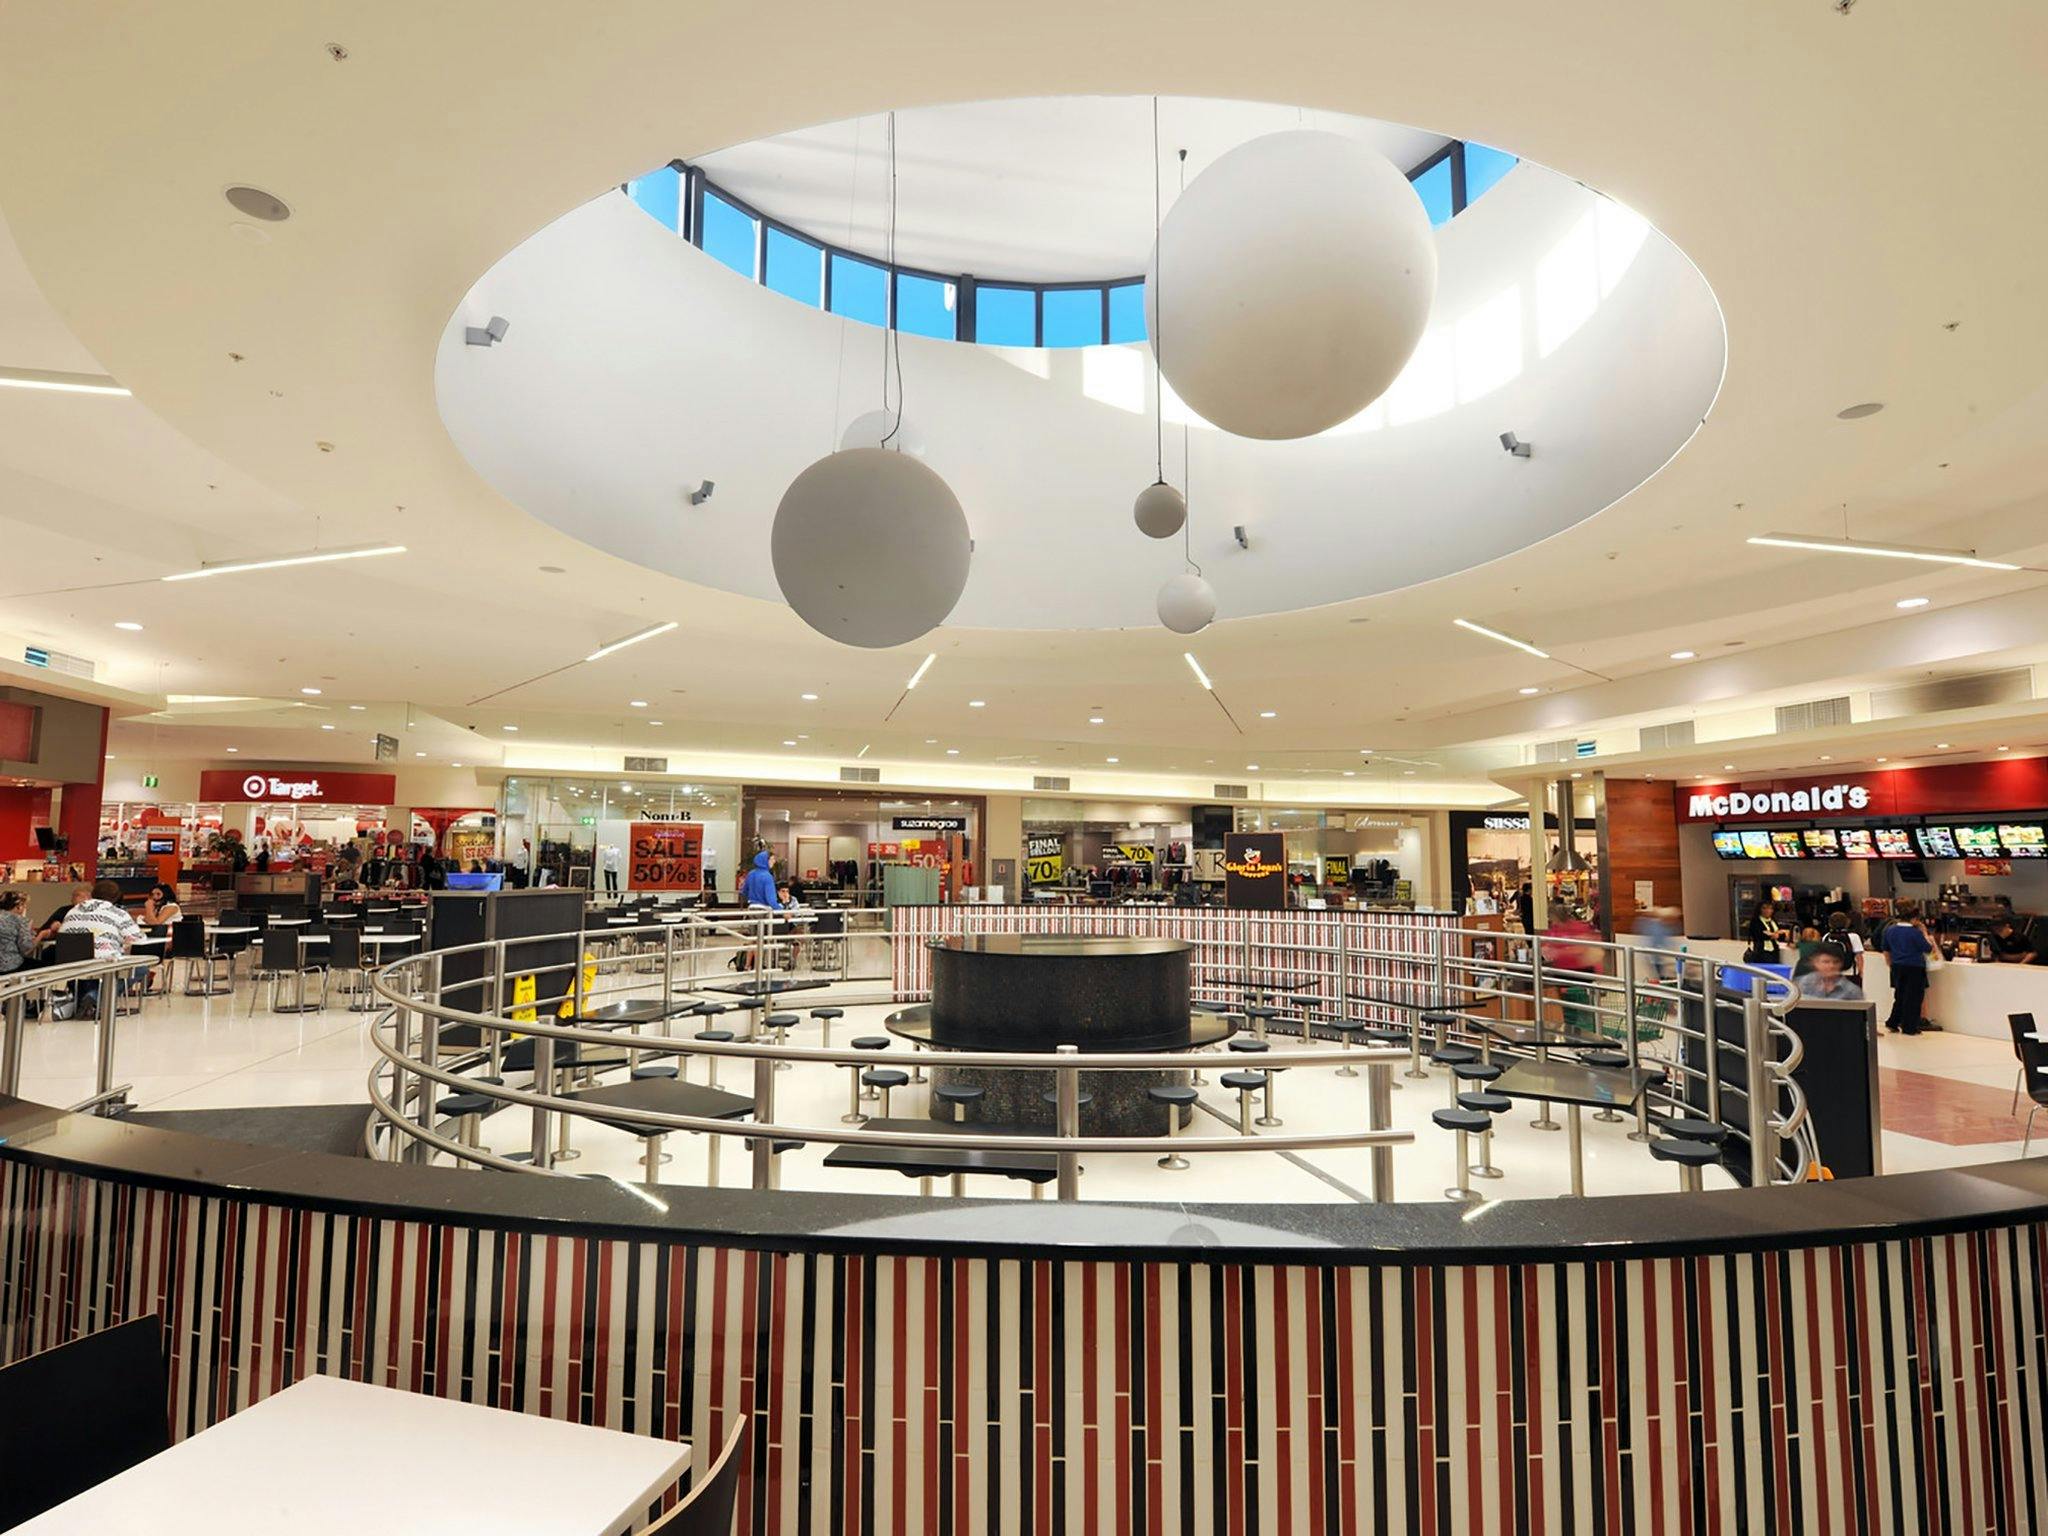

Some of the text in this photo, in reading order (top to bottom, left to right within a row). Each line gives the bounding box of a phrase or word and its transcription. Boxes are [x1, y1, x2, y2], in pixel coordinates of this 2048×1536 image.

[1688, 784, 1869, 818] McDonald's
[1483, 816, 1531, 830] sussa
[634, 838, 699, 859] SALE
[1028, 838, 1062, 850] FINAL
[634, 862, 688, 883] 50%
